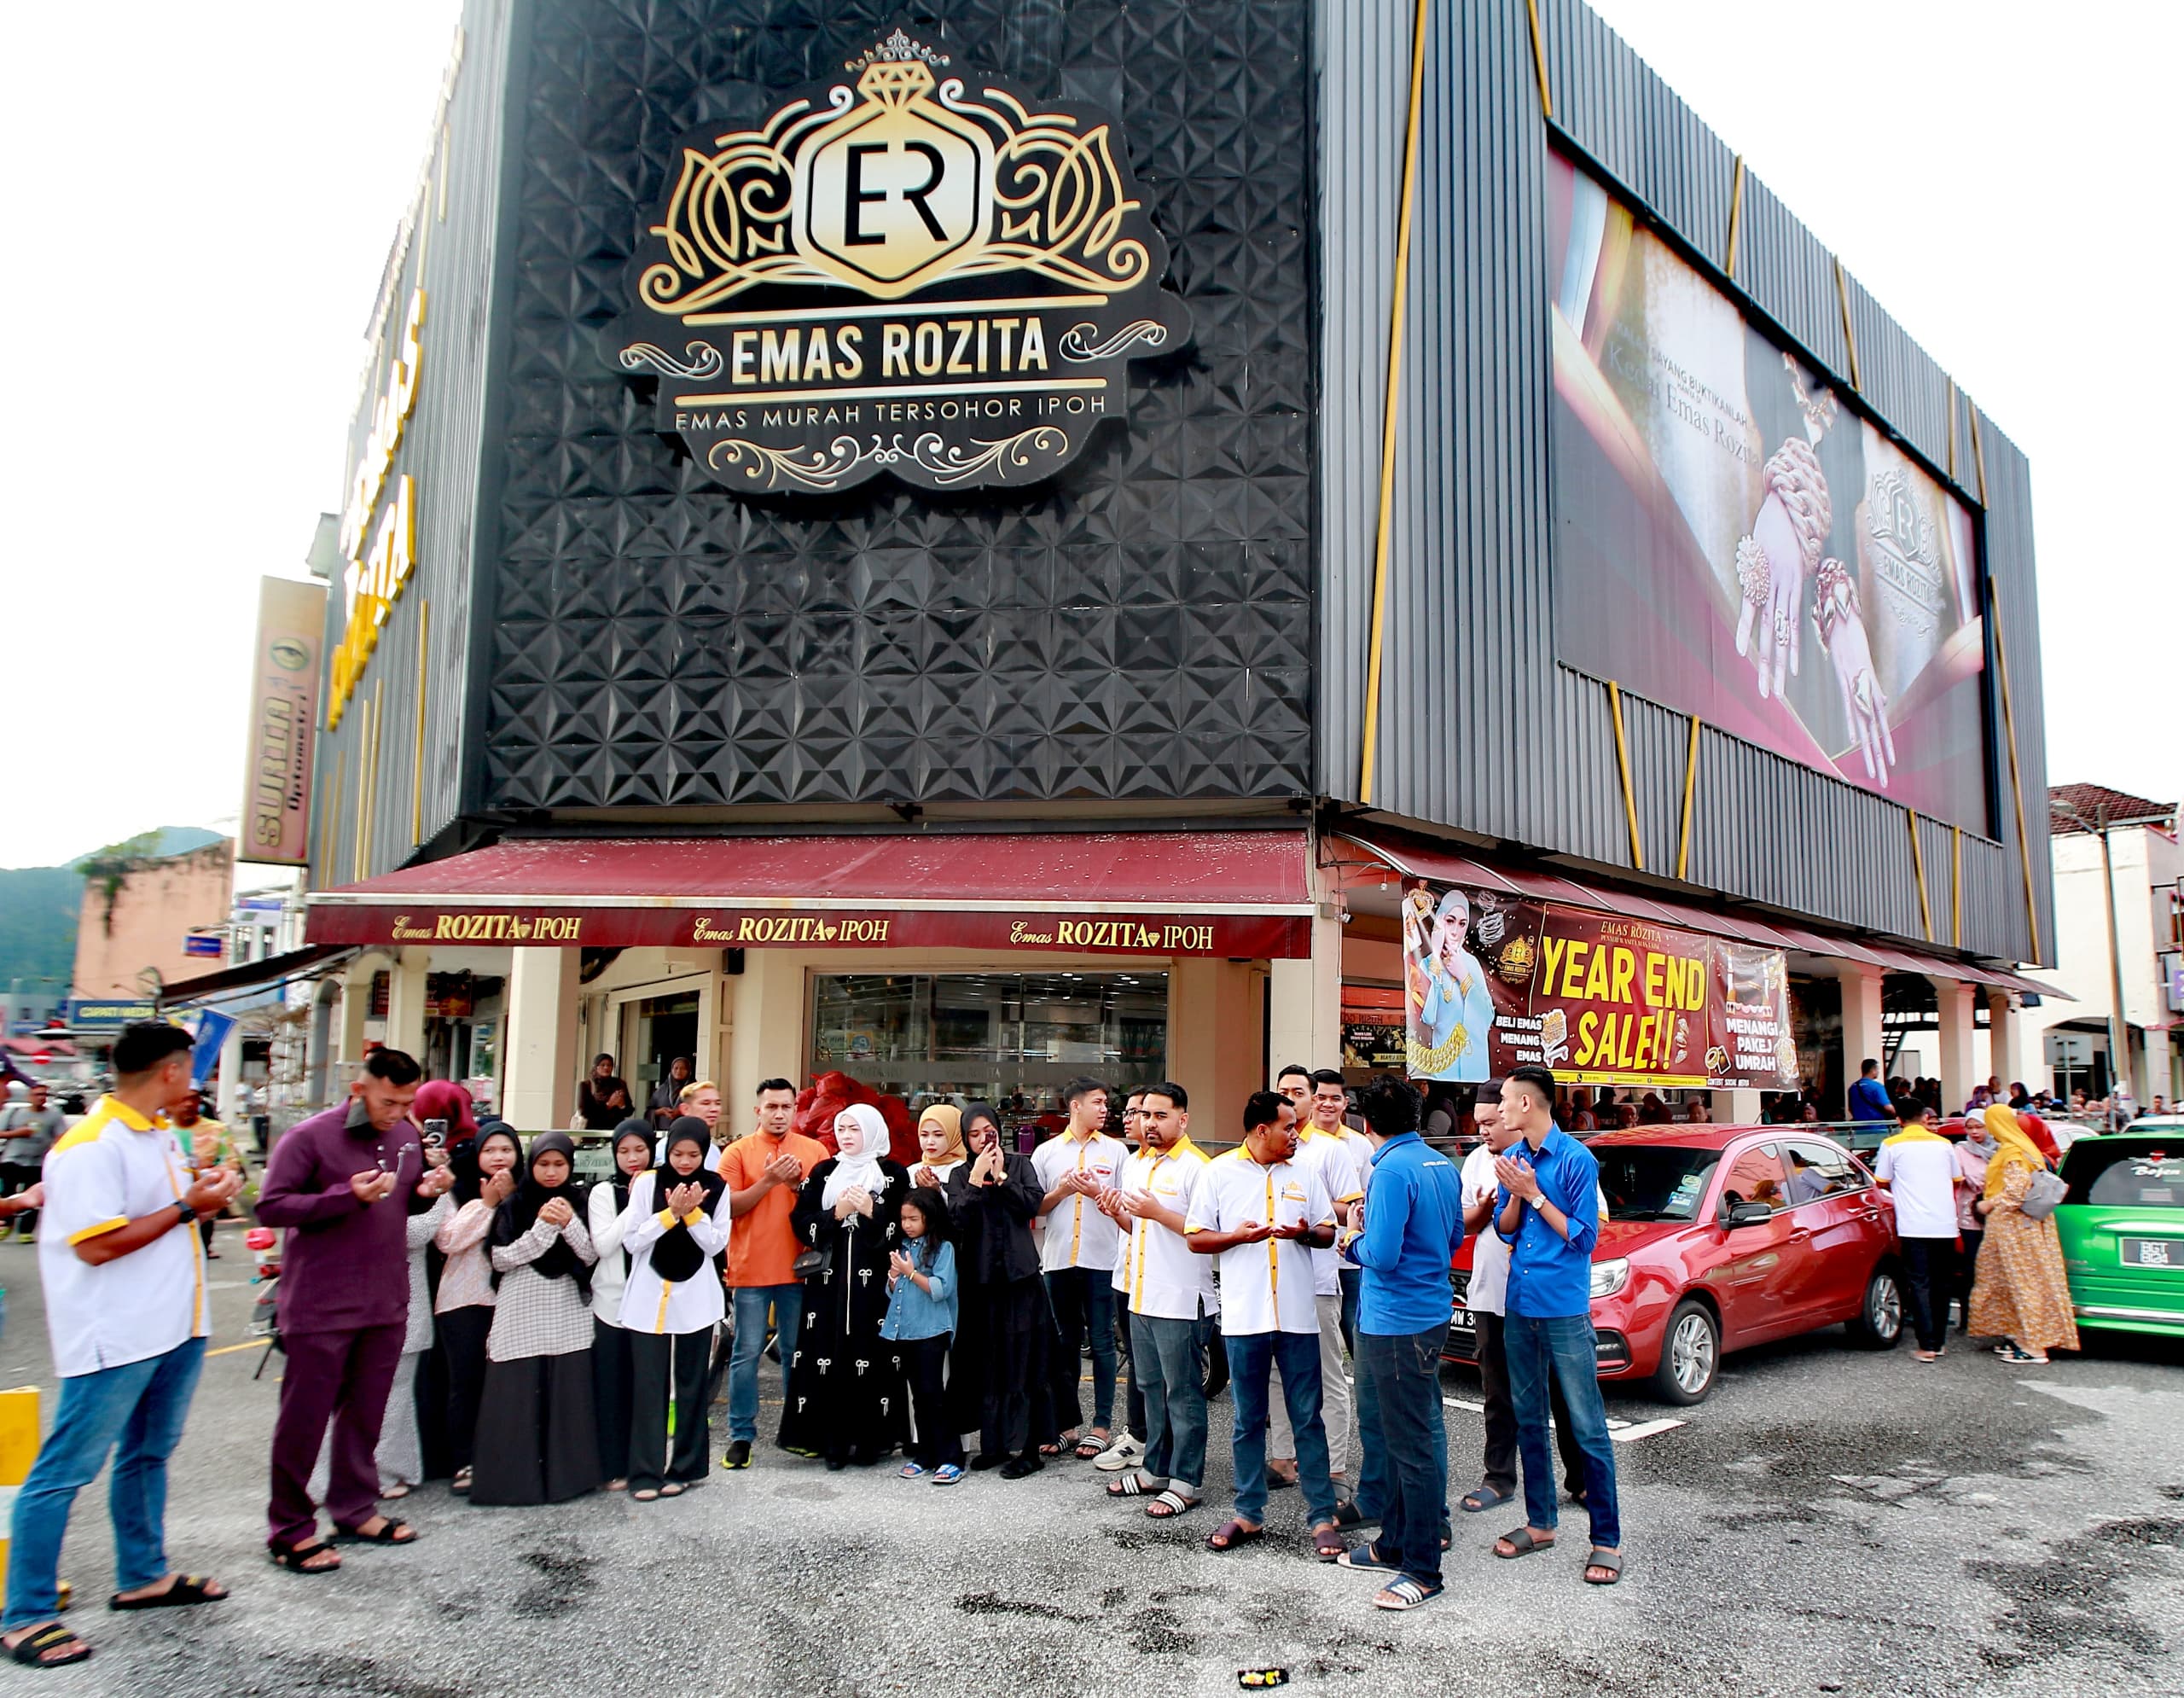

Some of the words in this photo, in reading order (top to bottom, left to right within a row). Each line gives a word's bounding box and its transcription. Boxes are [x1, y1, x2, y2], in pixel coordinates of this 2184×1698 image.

[844, 138, 950, 247] ER
[731, 325, 863, 385] EMAS
[881, 317, 1048, 378] ROZITA
[676, 410, 747, 430] EMAS
[762, 404, 860, 427] MURAH
[874, 398, 1022, 422] TERSOHOR
[1037, 394, 1106, 416] IPOH
[1667, 381, 1710, 436] Emas
[1689, 375, 1747, 429] BUKTIKANLAH
[1884, 555, 1905, 587] EMAS
[253, 696, 292, 847] SURIA
[392, 916, 432, 939] Emas
[434, 915, 520, 939] ROZITA
[531, 917, 582, 940] IPOH
[694, 917, 734, 942] Emas
[736, 917, 826, 942] ROZITA
[839, 920, 890, 942] IPOH
[1010, 921, 1052, 945] Emas
[1055, 921, 1150, 948] ROZITA
[1163, 925, 1214, 950] IPOH
[1600, 921, 1628, 936] EMAS
[1630, 925, 1662, 943] ROZITA
[1542, 936, 1635, 1003] YEAR
[1646, 951, 1705, 1011] END
[1496, 1016, 1516, 1027] BELI
[1517, 1018, 1542, 1031] EMAS
[1726, 1017, 1778, 1036] MENANGI
[1501, 1032, 1541, 1046] MENANG
[1574, 1009, 1676, 1070] SALE!!
[1737, 1037, 1773, 1053] PAKEJ
[1516, 1050, 1542, 1062] EMAS
[1734, 1055, 1776, 1071] UMRAH
[1467, 1311, 1476, 1326] 3
